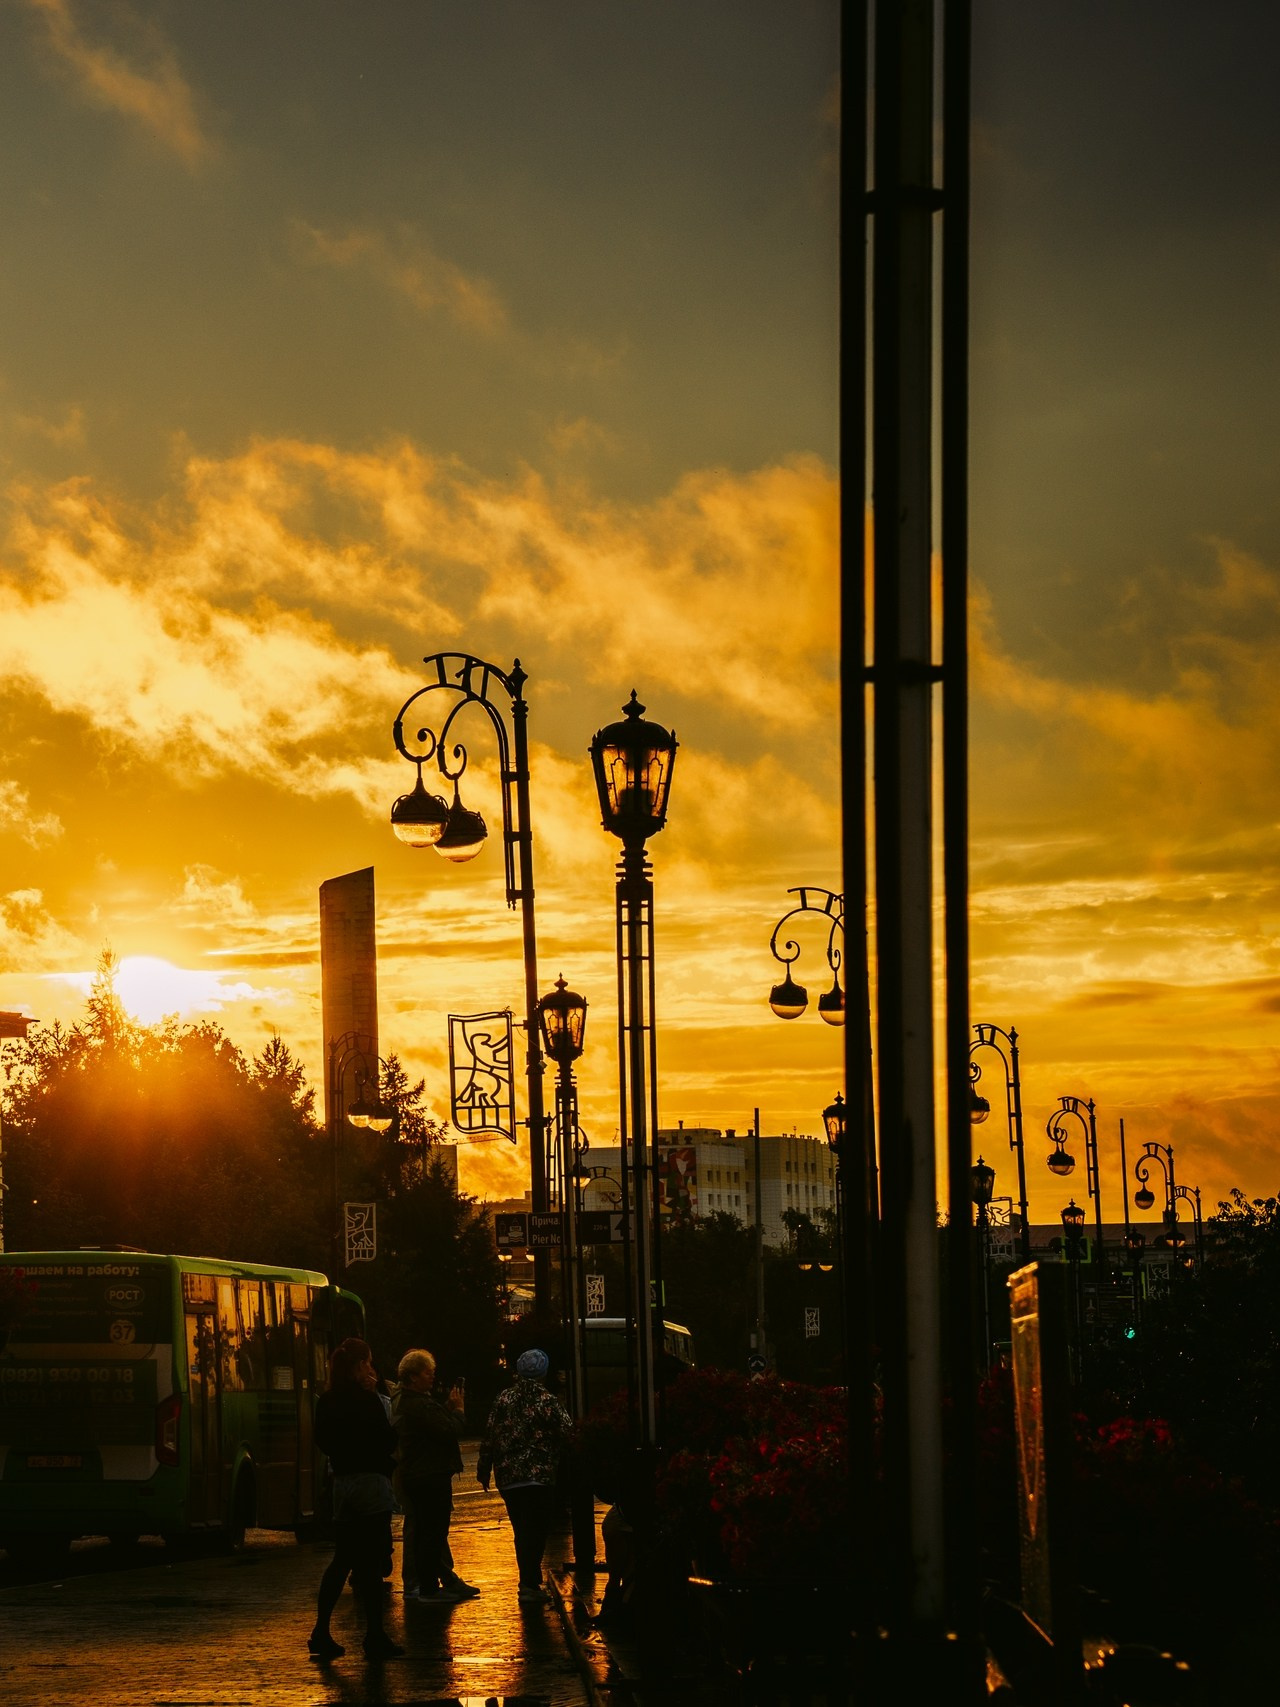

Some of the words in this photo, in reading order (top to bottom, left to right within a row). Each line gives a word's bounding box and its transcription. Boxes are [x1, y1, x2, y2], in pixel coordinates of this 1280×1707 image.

[531, 1215, 561, 1229] Прича
[532, 1233, 549, 1245] Pier
[67, 1266, 83, 1276] на
[87, 1263, 140, 1277] работу:
[109, 1289, 140, 1301] РОСТ
[113, 1325, 133, 1340] 37
[0, 1367, 44, 1385] (982)
[48, 1368, 81, 1383] 930
[87, 1368, 110, 1383] 00
[115, 1368, 134, 1383] 18
[112, 1388, 135, 1403] 03
